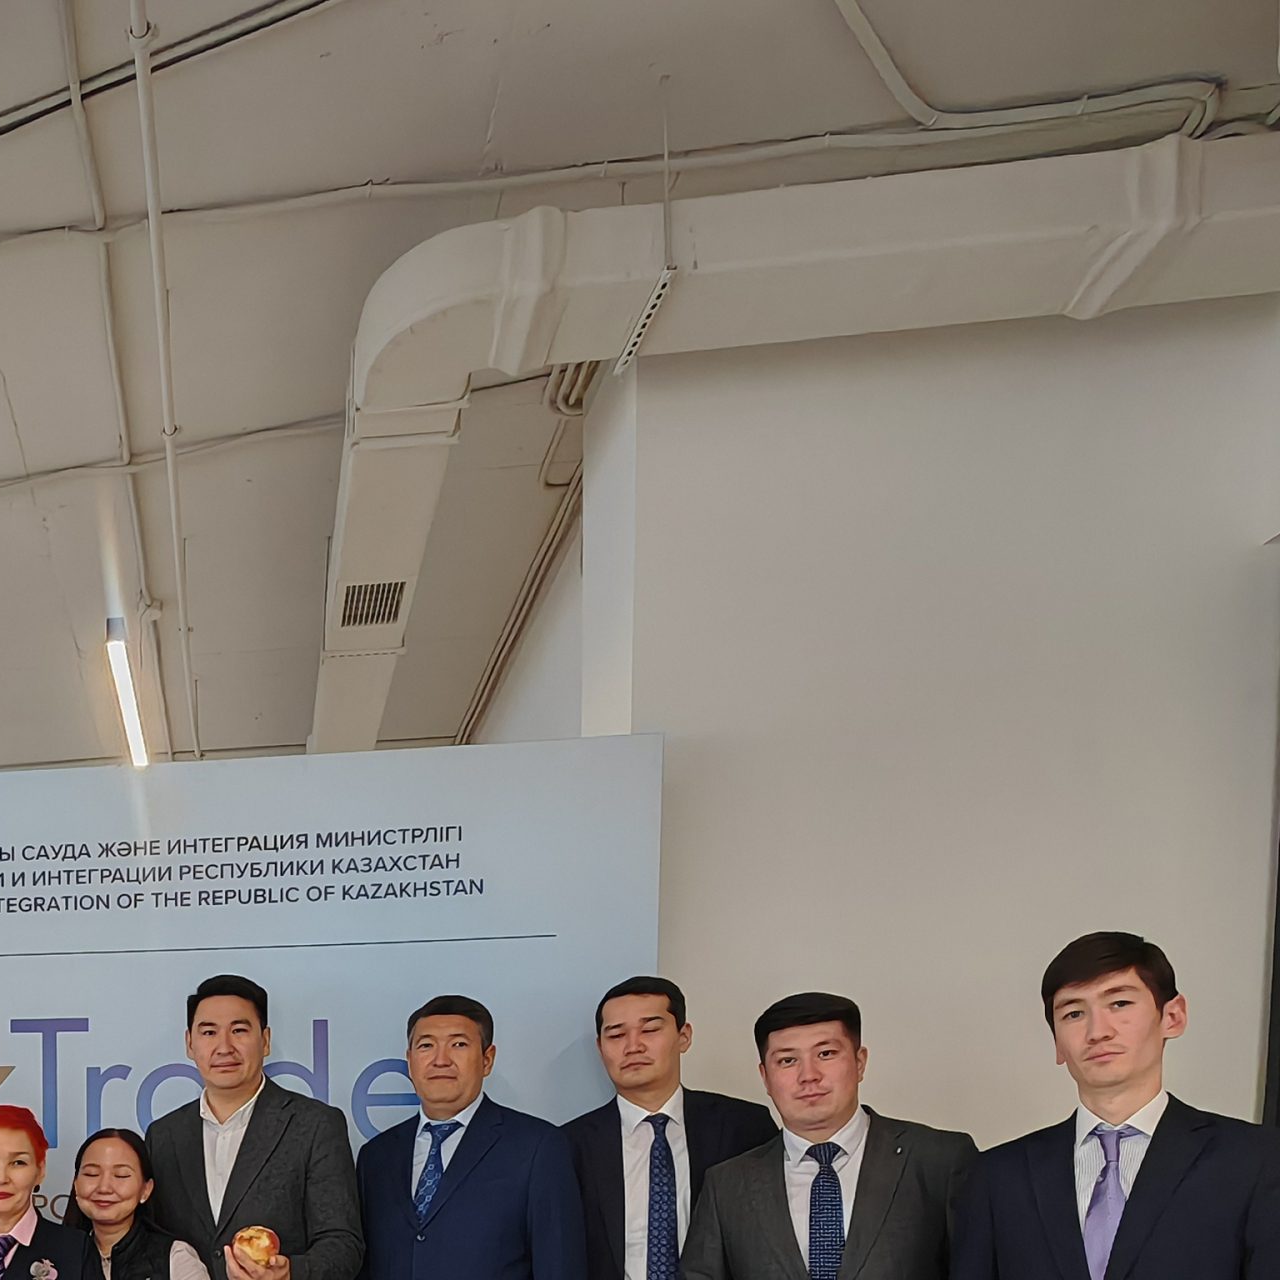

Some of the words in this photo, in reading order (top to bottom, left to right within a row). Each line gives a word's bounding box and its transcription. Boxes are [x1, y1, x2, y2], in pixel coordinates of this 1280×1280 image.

[22, 843, 91, 862] САУДА
[98, 840, 161, 858] ЖӘНЕ
[167, 833, 308, 856] ИНТЕГРАЦИЯ
[316, 826, 463, 848] МИНИСТРЛІГІ
[12, 871, 26, 888] И
[32, 866, 173, 887] ИНТЕГРАЦИИ
[179, 860, 325, 881] РЕСПУБЛИКИ
[332, 853, 461, 874] КАЗАХСТАН
[116, 893, 145, 909] OF
[151, 891, 192, 908] THE
[198, 886, 300, 906] REPUBLIC
[306, 885, 336, 902] OF
[342, 878, 485, 900] KAZAKHSTAN
